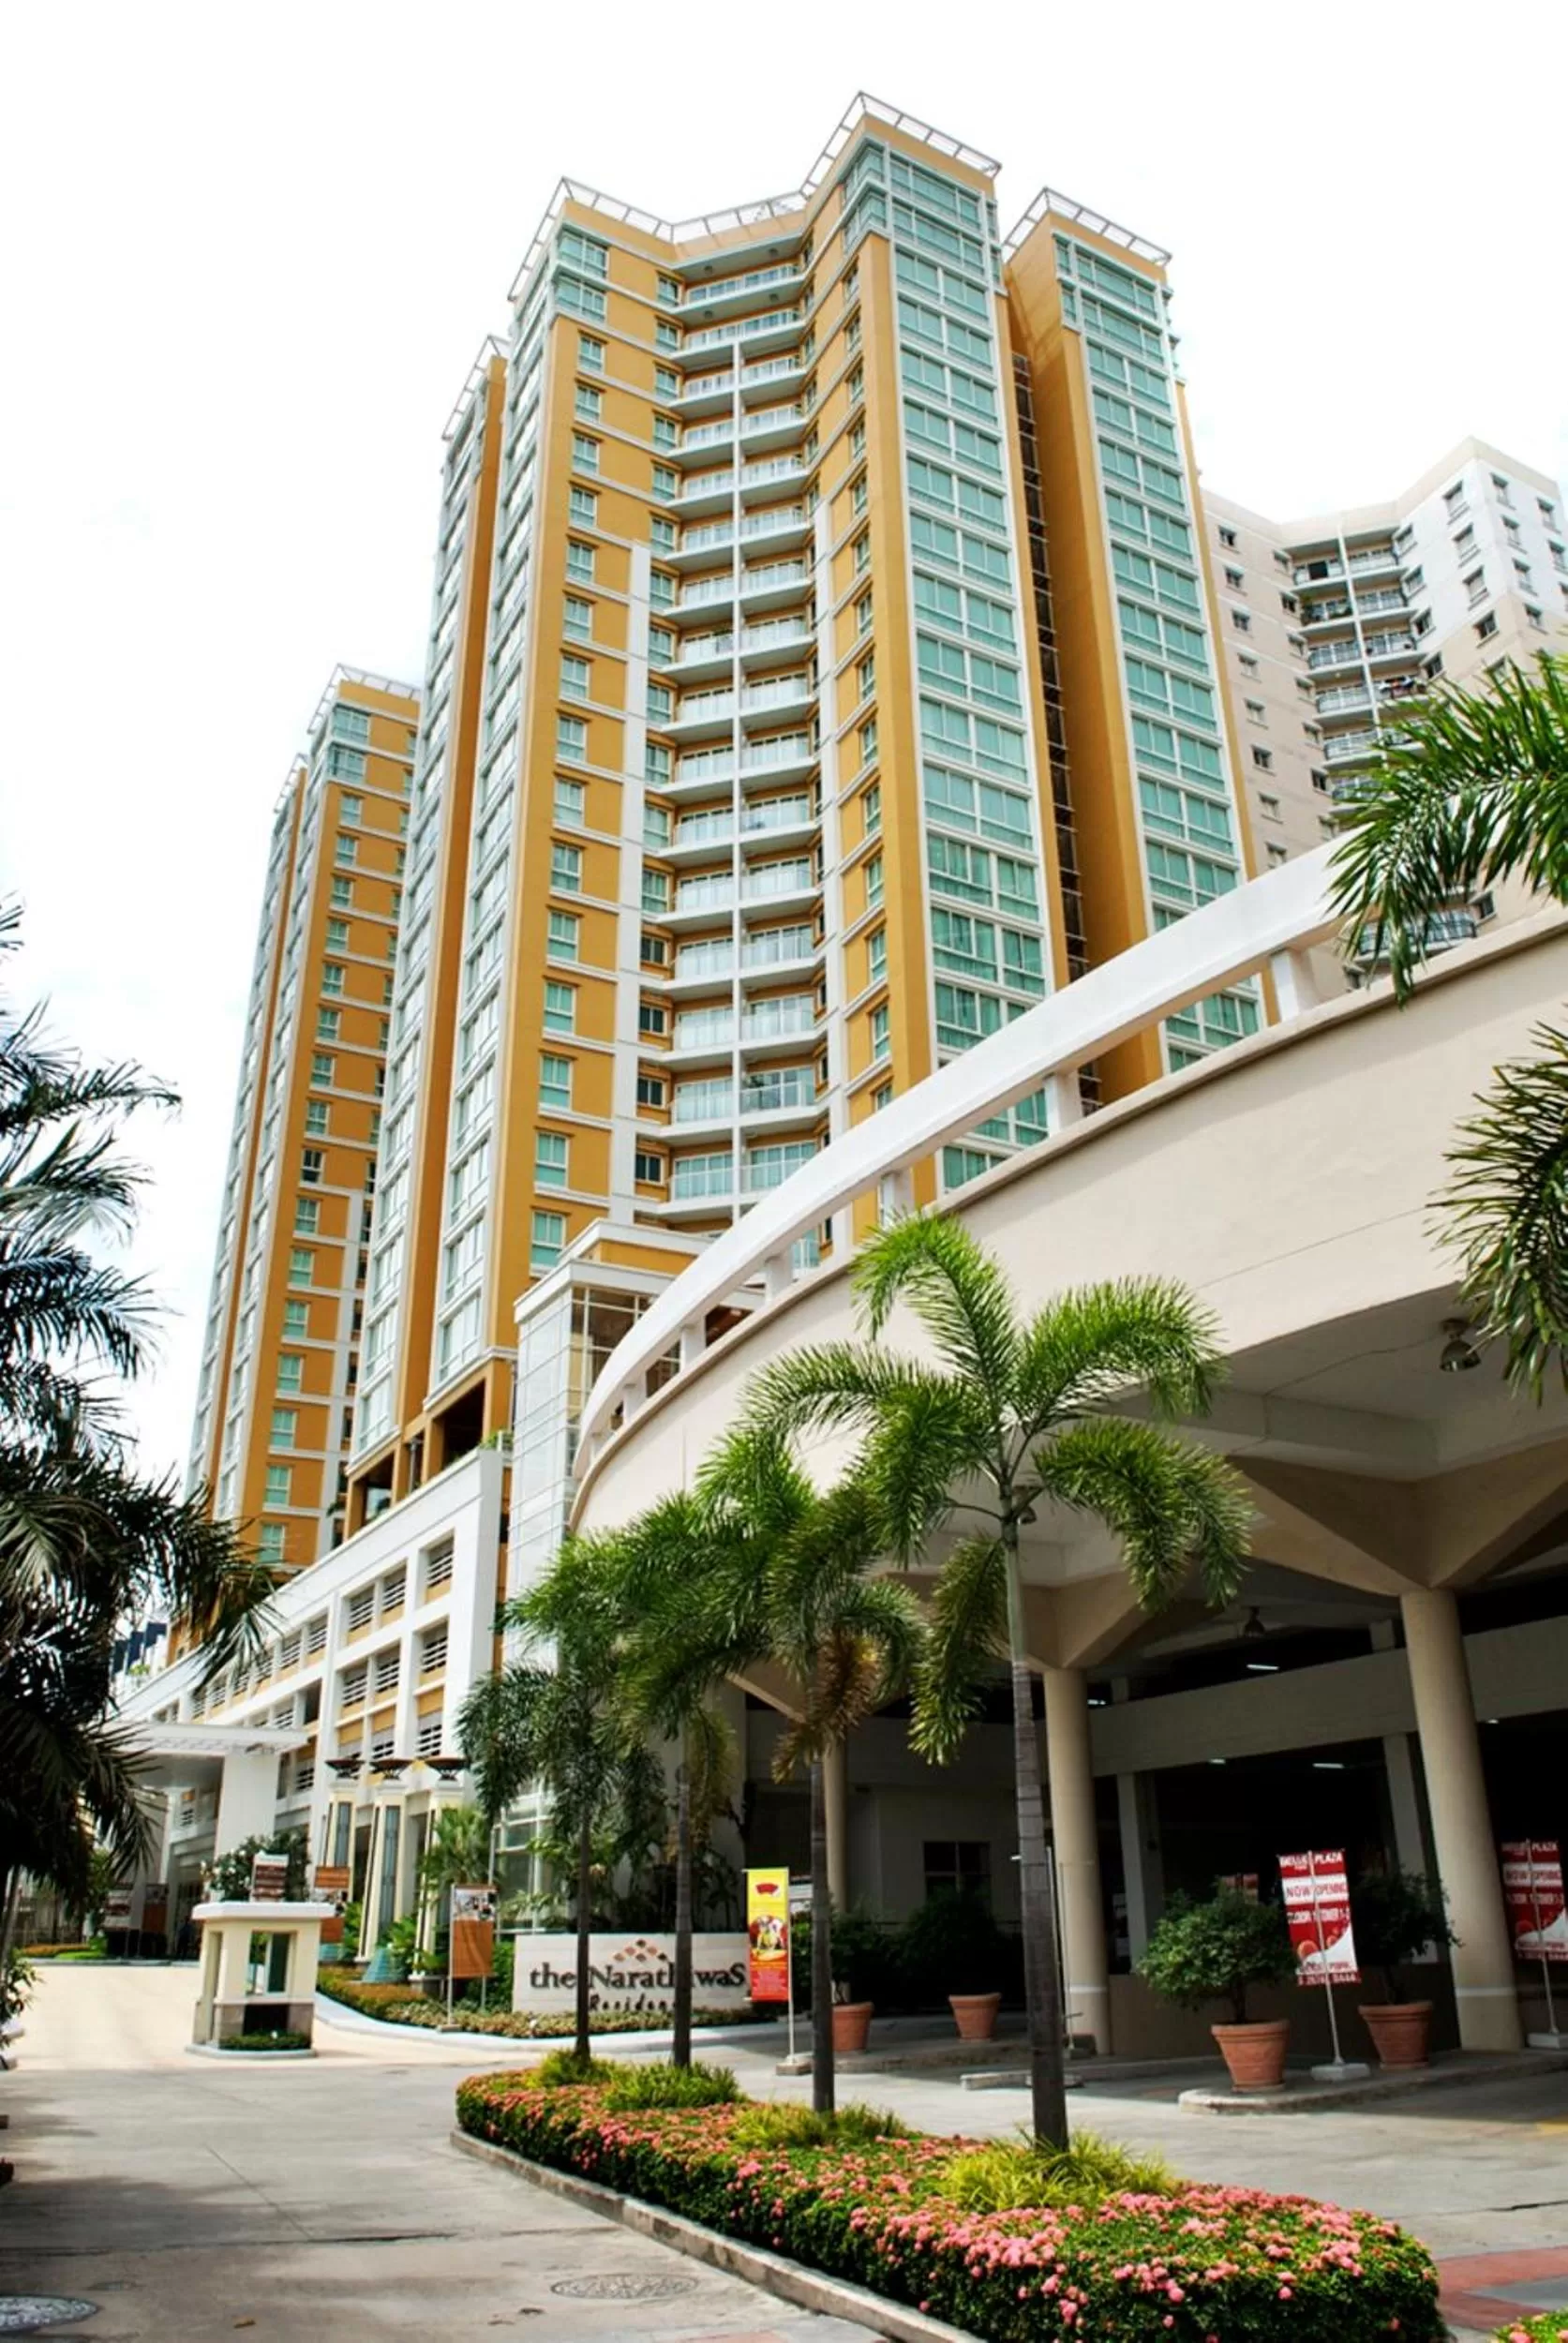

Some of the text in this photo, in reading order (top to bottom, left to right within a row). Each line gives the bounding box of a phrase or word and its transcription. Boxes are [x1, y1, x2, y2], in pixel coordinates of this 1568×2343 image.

[1314, 1851, 1343, 1864] PLAZA
[1287, 1885, 1310, 1897] NOW
[530, 1962, 577, 1989] the
[588, 1962, 746, 1989] NaratwaS
